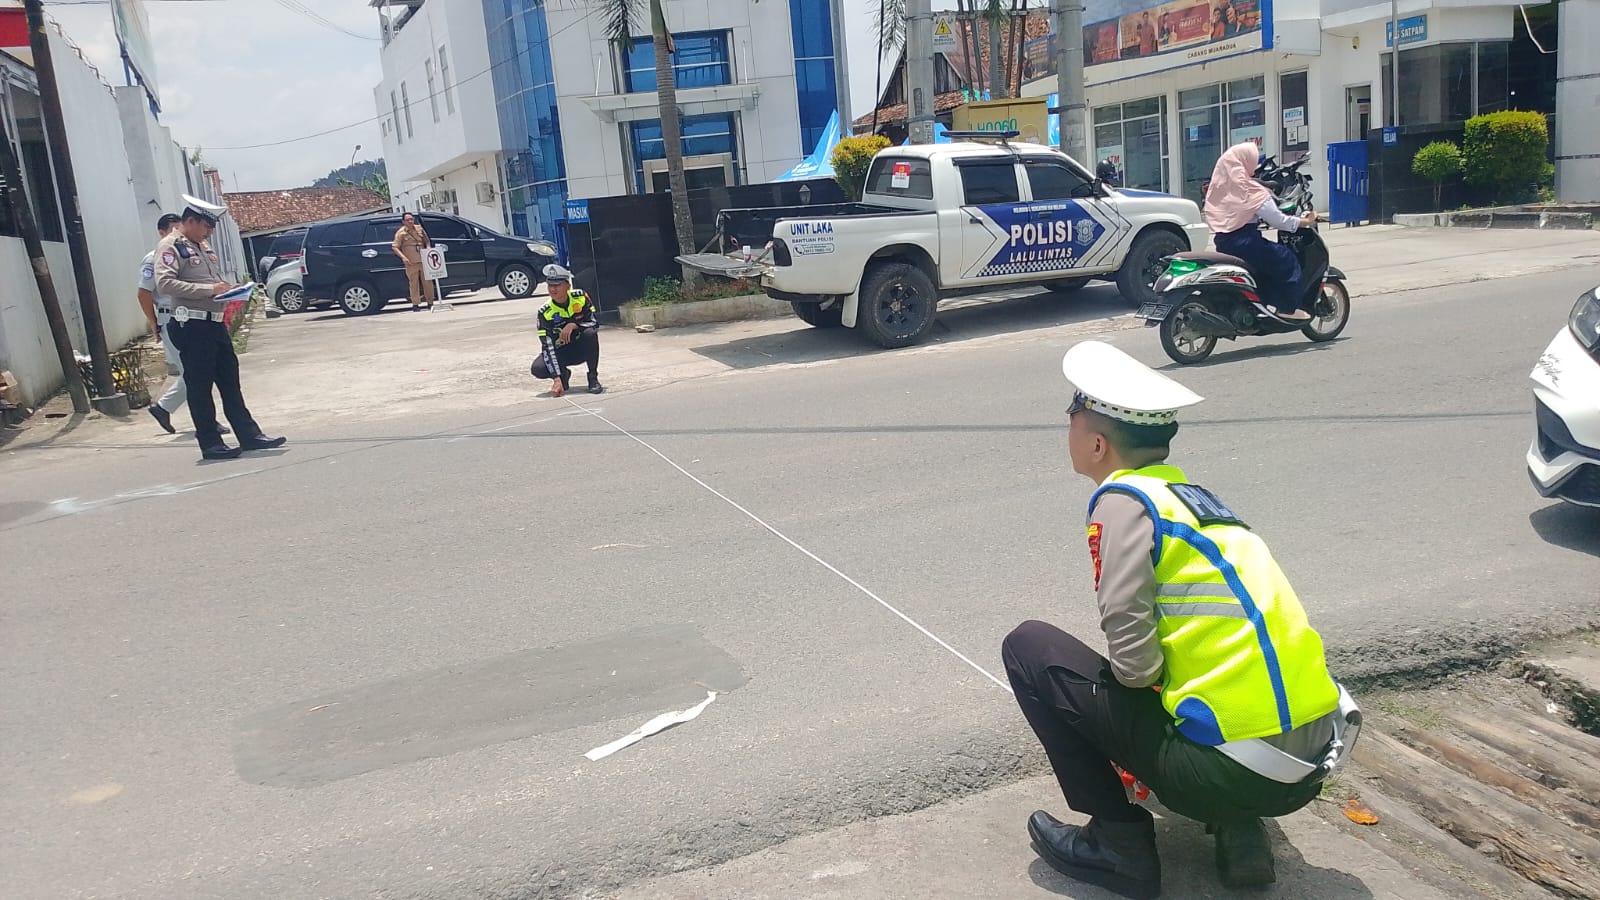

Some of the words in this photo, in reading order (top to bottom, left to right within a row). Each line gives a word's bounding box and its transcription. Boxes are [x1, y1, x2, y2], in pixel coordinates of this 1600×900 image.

[567, 207, 588, 219] MASUK
[790, 222, 810, 236] UNIT
[811, 221, 834, 235] LAKA
[1010, 220, 1073, 247] POLISI
[1009, 250, 1036, 263] LALU
[1038, 247, 1073, 260] LINTAS
